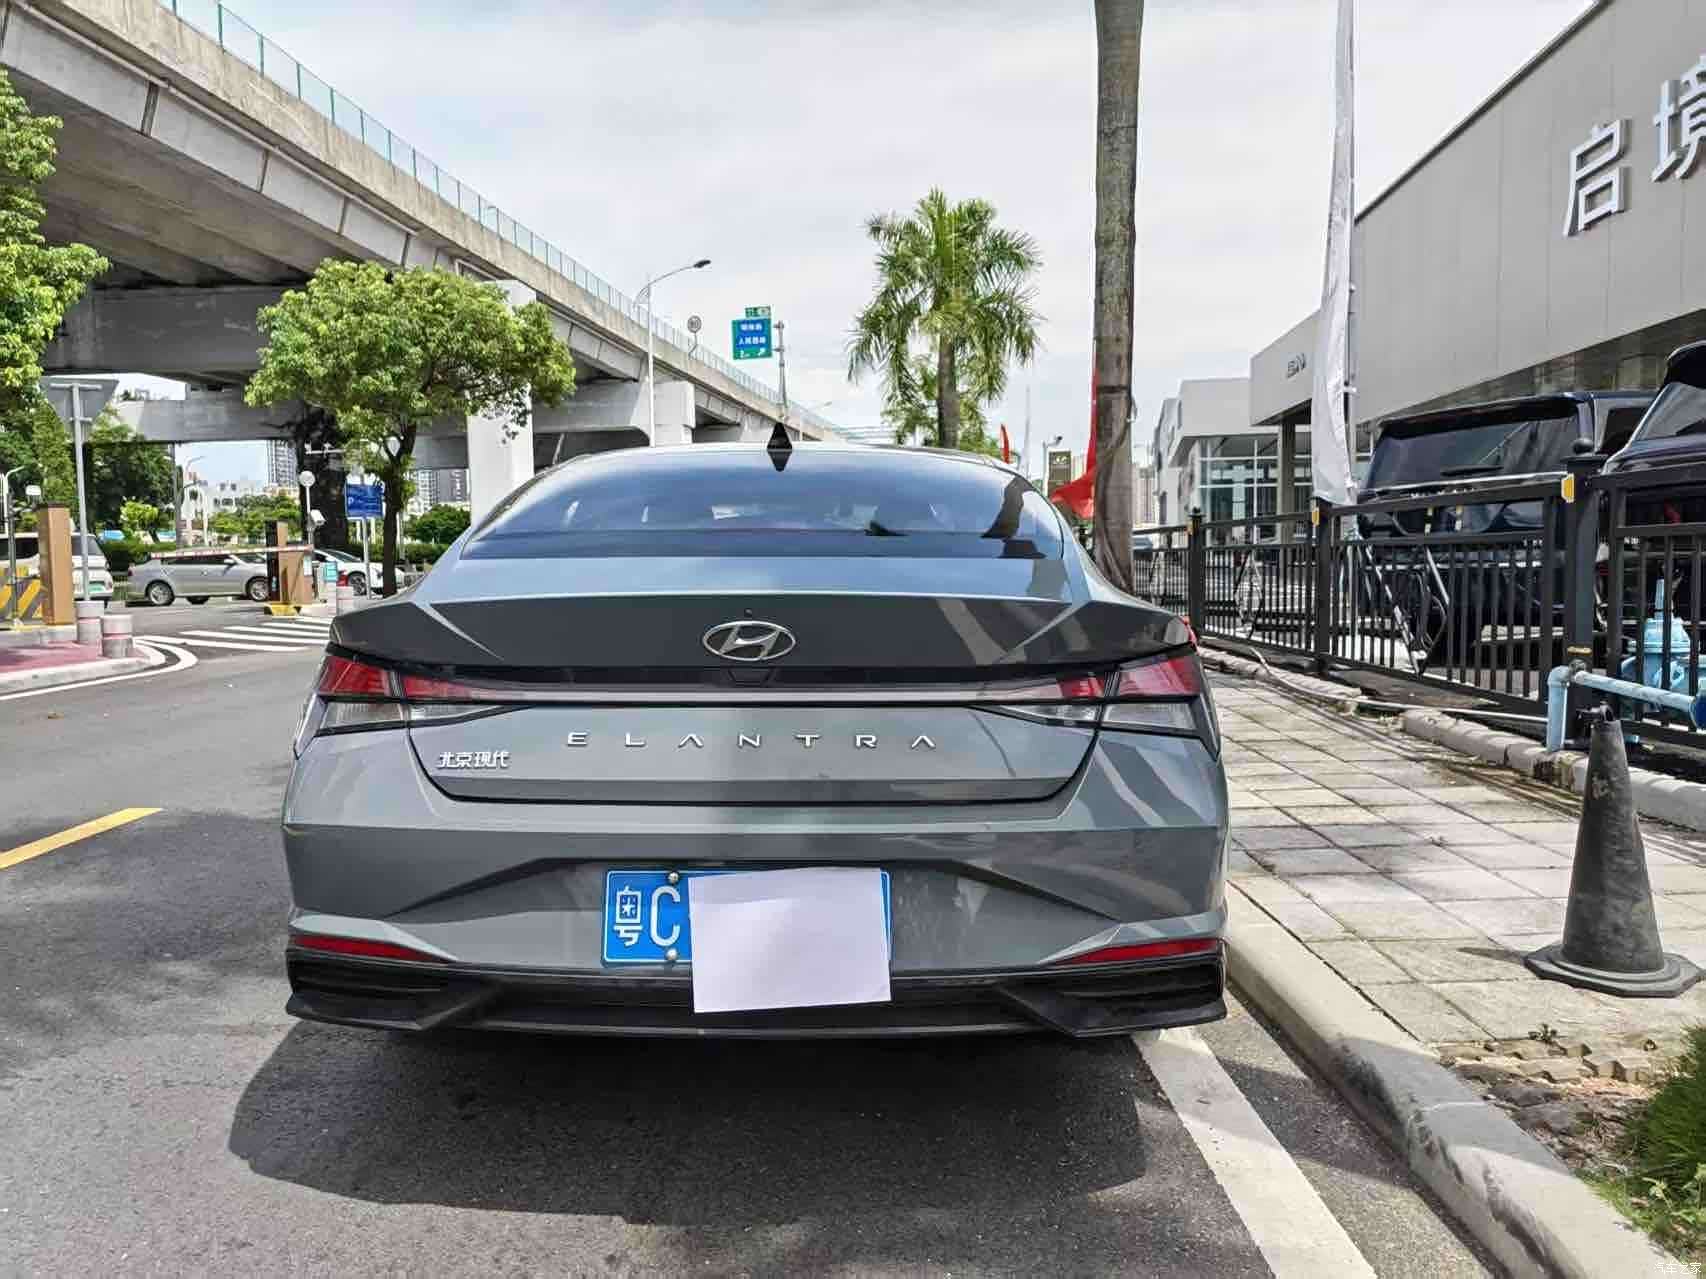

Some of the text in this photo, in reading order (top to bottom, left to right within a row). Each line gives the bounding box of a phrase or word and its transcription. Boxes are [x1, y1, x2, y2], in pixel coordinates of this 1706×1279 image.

[566, 731, 937, 748] ELANTRA
[437, 750, 510, 769] 北京现代
[613, 885, 681, 947] 粤C
